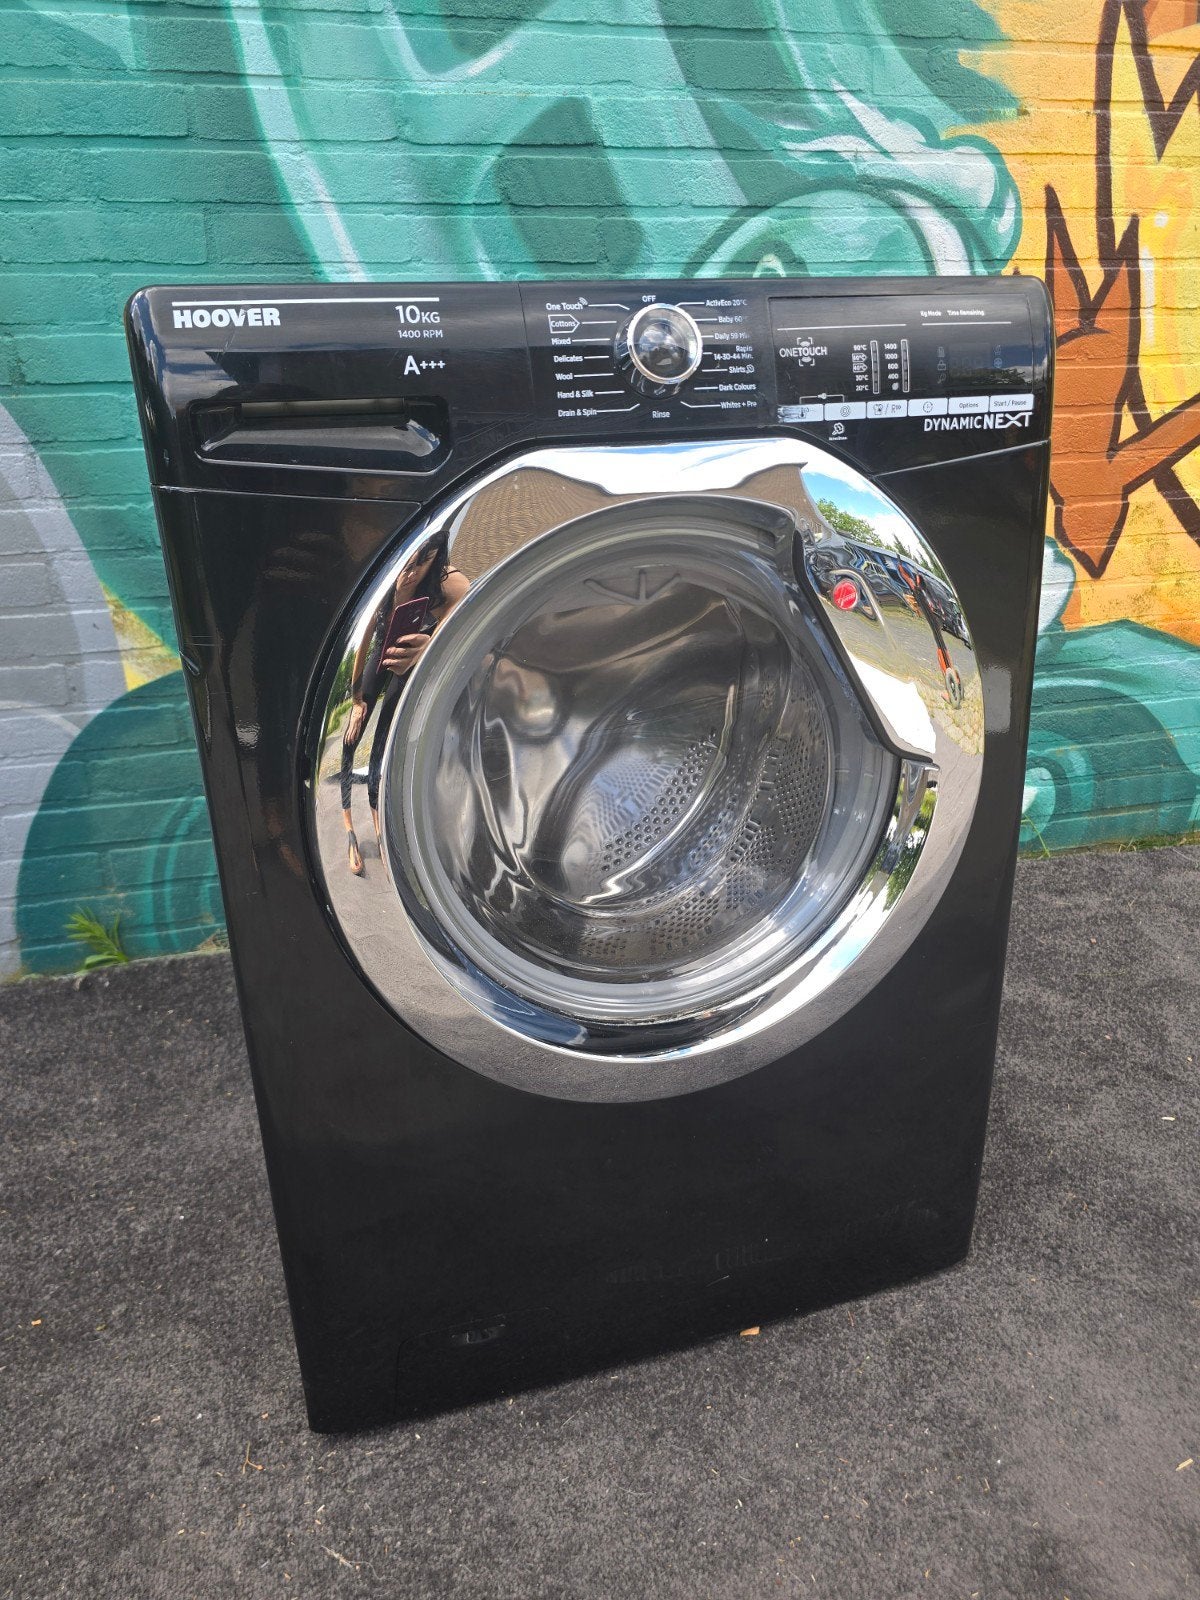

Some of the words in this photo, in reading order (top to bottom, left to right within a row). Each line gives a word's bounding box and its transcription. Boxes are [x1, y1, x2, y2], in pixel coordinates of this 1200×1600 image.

[545, 302, 561, 310] One
[561, 302, 584, 310] Touch
[172, 307, 281, 329] HOOVER
[395, 305, 441, 324] 10KG
[550, 320, 577, 328] Cottons
[398, 330, 421, 338] 1400
[422, 329, 444, 338] RPM
[714, 332, 730, 340] Daily
[779, 346, 828, 358] ONETOUCH
[553, 355, 584, 363] Delicates
[403, 355, 446, 376] A+++
[555, 373, 574, 381] Wool
[733, 383, 757, 391] Colours
[557, 391, 575, 399] Hand
[581, 389, 595, 398] Silk
[557, 409, 576, 417] Drain
[582, 408, 598, 417] Spin
[652, 410, 671, 419] Rinse
